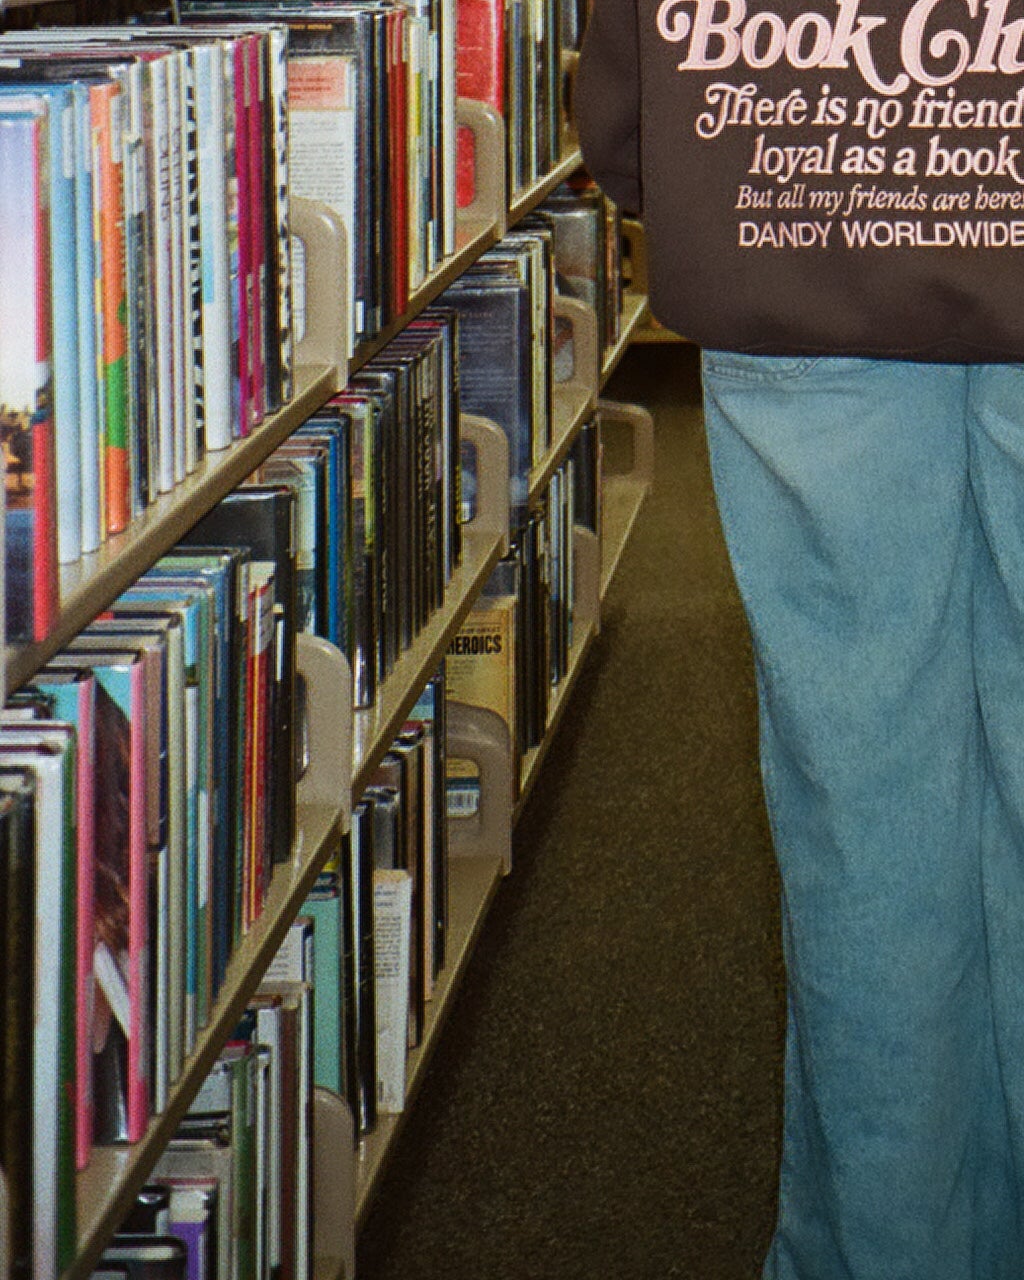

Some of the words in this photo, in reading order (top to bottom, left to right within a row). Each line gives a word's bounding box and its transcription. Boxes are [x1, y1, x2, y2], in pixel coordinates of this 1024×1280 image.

[696, 82, 806, 138] There
[811, 83, 848, 125] is
[857, 88, 902, 138] no
[748, 133, 837, 182] loyal
[840, 145, 886, 174] as
[892, 147, 917, 176] a
[735, 184, 772, 208] But
[777, 181, 806, 208] all
[809, 190, 843, 215] my
[843, 183, 928, 216] friends
[932, 191, 971, 211] are
[739, 221, 832, 247] DANDY
